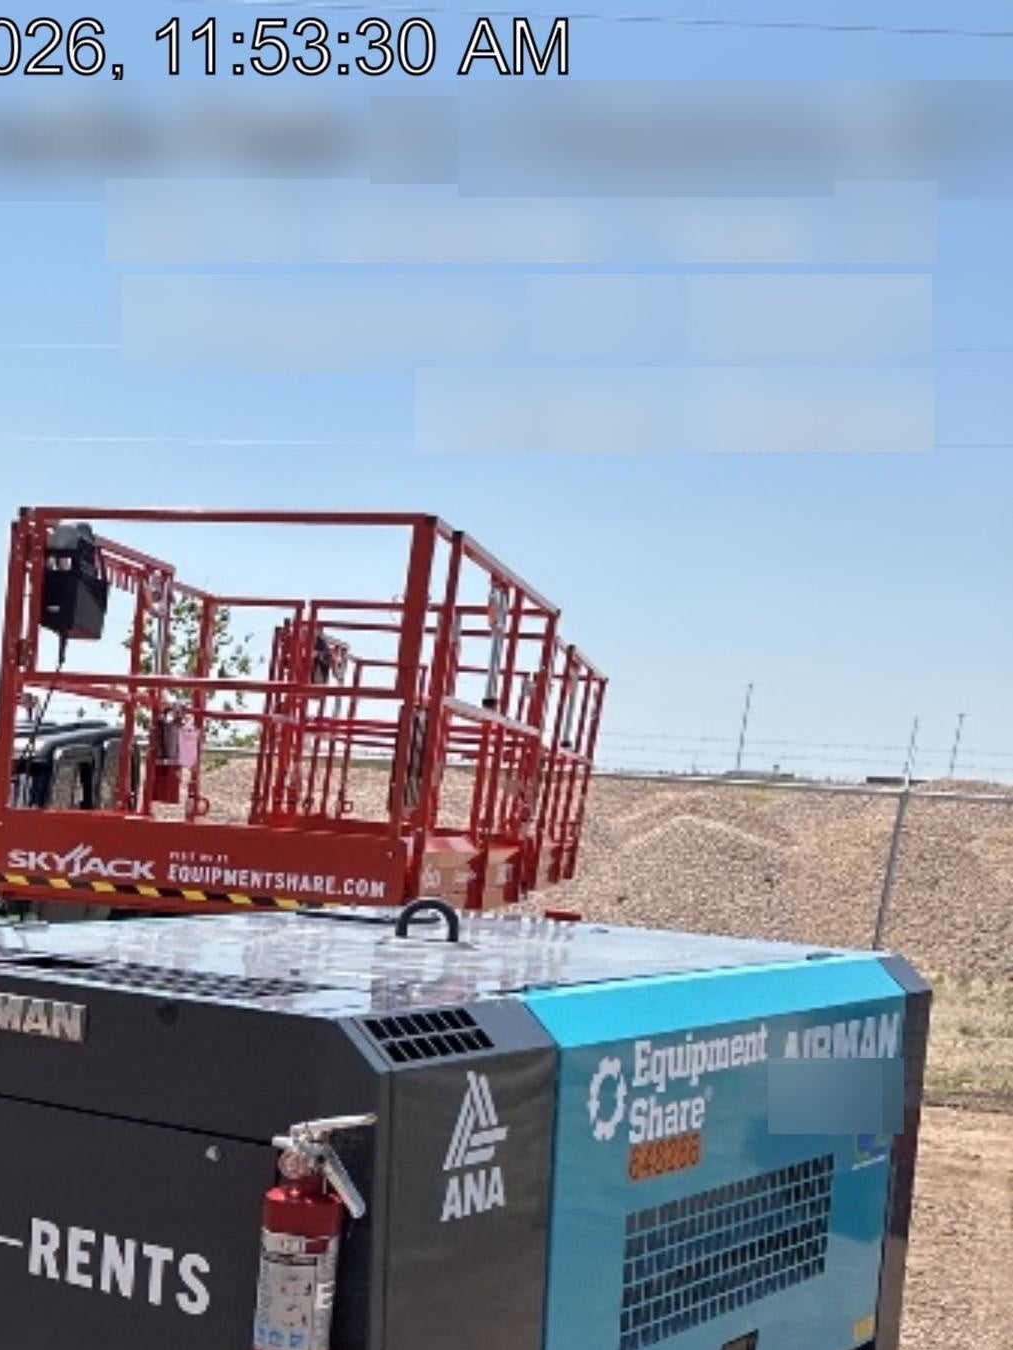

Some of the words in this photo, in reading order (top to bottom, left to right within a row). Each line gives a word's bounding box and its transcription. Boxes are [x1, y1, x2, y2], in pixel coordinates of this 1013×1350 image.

[7, 841, 156, 881] SKYJACK
[167, 863, 386, 898] EQUIPMENTSHARE.COM
[631, 1023, 768, 1092] Equipment
[784, 1011, 901, 1058] AIRMAN
[628, 1096, 706, 1144] Share
[440, 1166, 506, 1222] ANA
